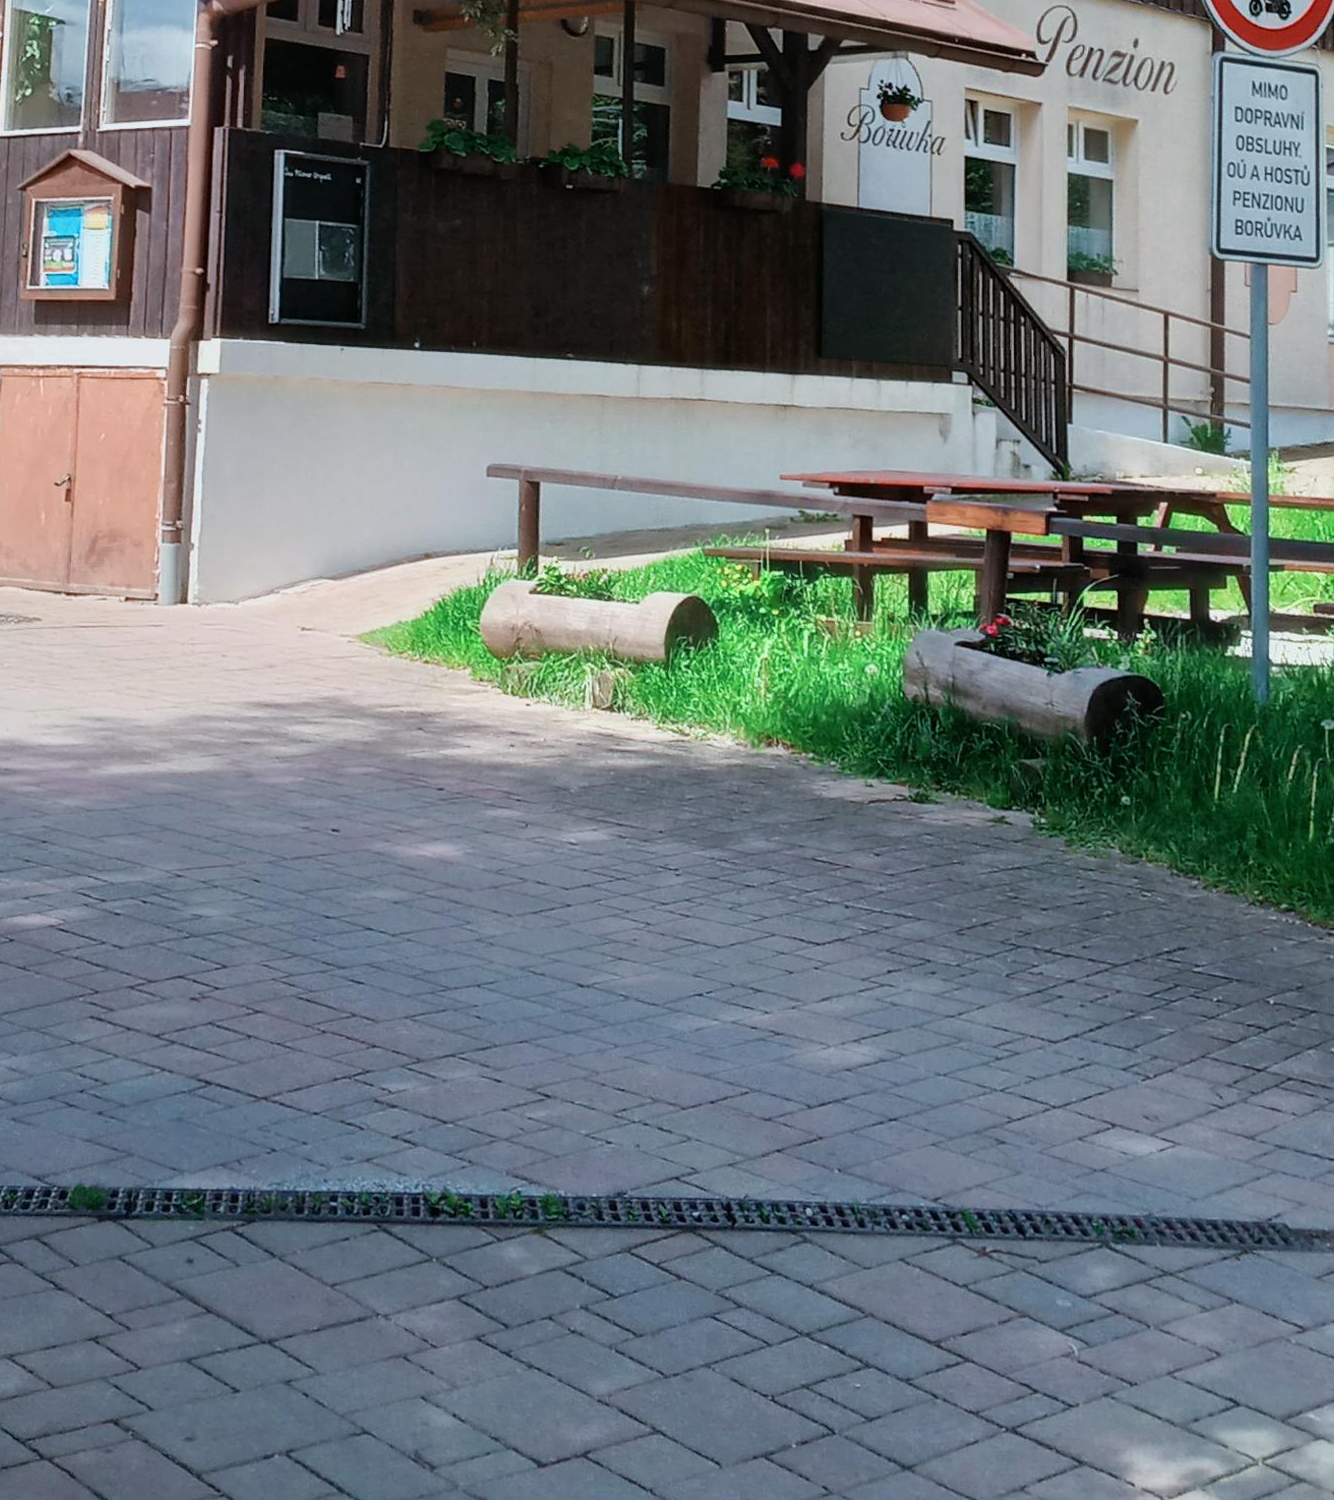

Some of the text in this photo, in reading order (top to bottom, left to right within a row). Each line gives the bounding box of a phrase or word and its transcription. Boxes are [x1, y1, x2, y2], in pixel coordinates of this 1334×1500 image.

[1036, 4, 1178, 95] Penzion
[1251, 80, 1289, 101] MIMO
[1234, 106, 1305, 131] DOPRAVNÍ
[1250, 165, 1260, 181] A
[1264, 164, 1310, 187] HOSTŮ
[1232, 190, 1305, 214] PENZIONU
[1234, 216, 1303, 242] BORŮVKA
